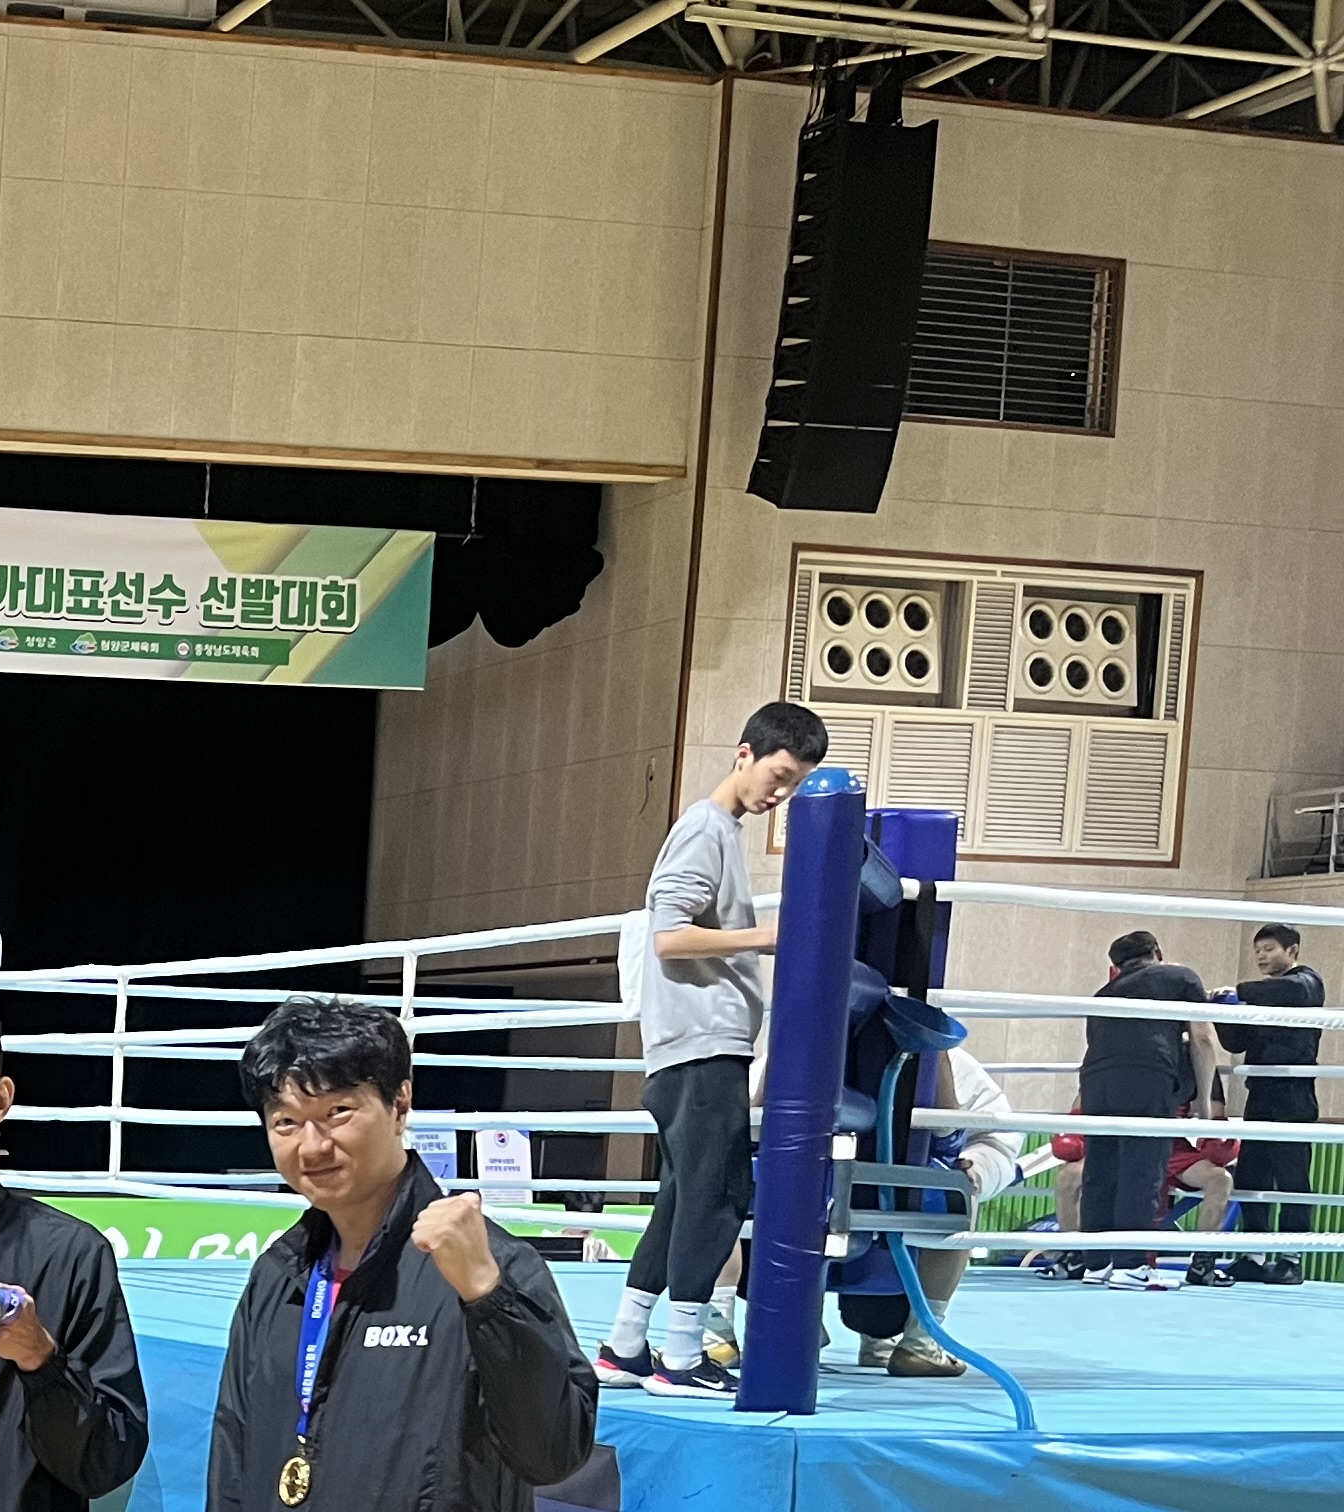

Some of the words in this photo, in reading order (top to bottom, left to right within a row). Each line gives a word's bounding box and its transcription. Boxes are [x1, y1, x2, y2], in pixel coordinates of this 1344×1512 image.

[200, 575, 358, 628] 선발대회
[312, 1280, 325, 1319] BOXING
[363, 1325, 429, 1347] BOX-1
